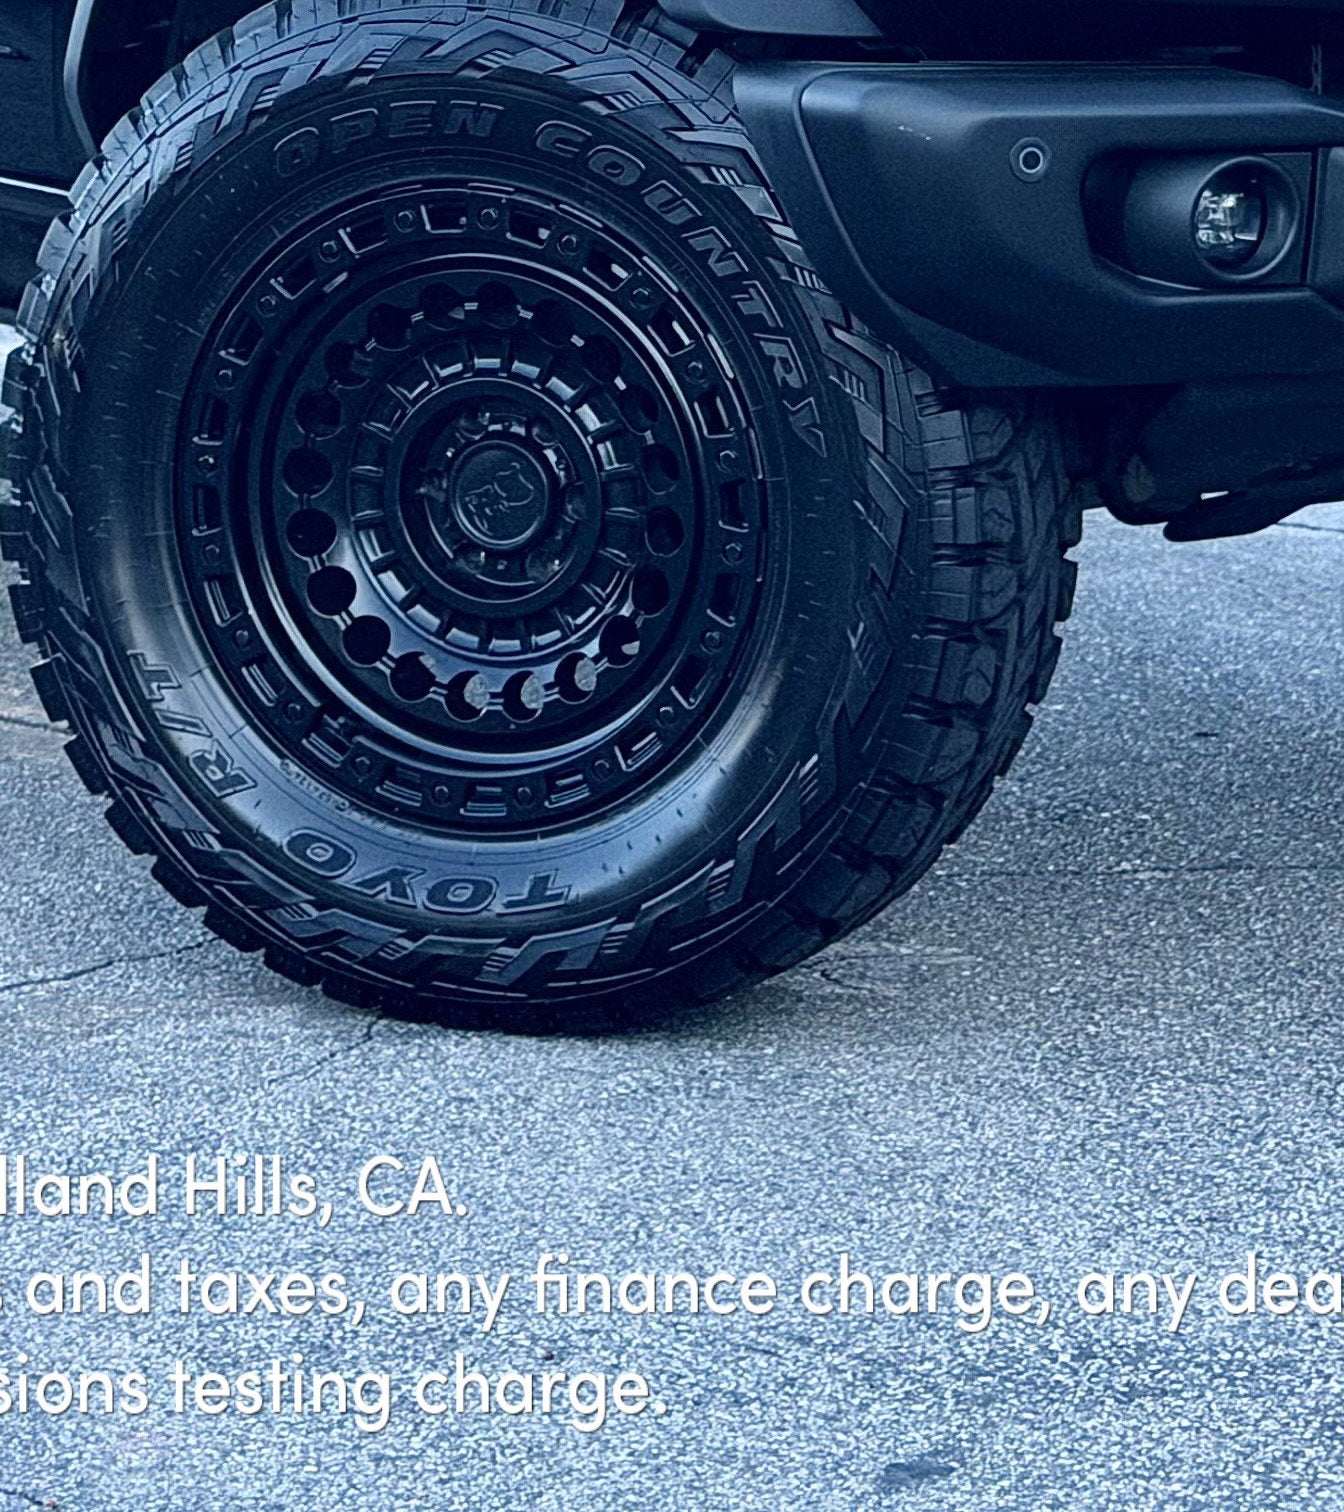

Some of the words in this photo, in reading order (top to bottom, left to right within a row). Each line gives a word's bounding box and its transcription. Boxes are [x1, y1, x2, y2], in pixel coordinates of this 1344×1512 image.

[273, 99, 505, 178] OPEN
[534, 119, 828, 458] COUNTRY
[125, 648, 257, 799] R/T
[282, 826, 573, 917] TOYO
